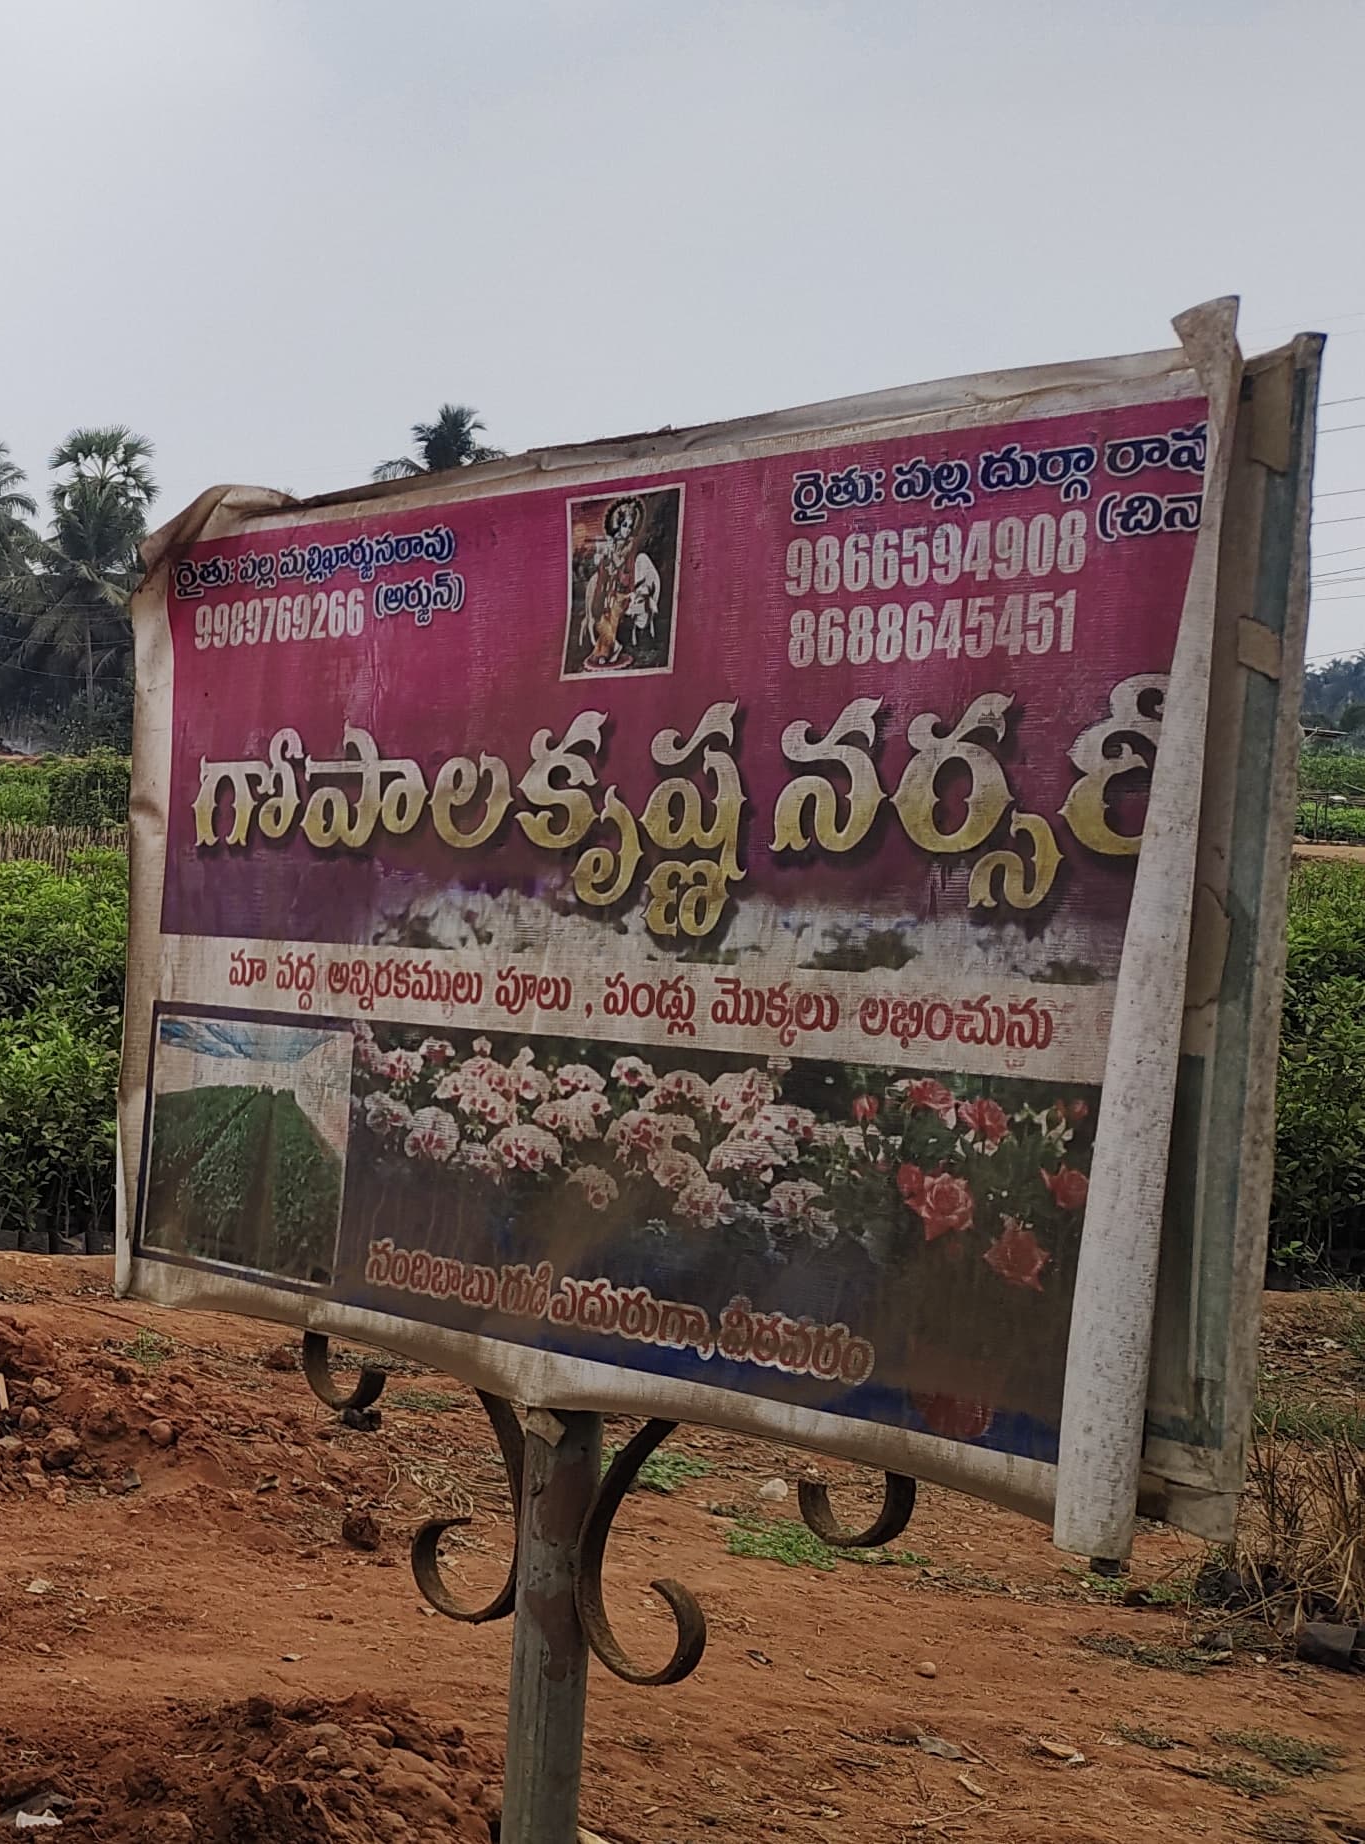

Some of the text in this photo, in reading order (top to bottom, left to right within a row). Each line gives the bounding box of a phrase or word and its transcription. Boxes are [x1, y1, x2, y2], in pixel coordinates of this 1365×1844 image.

[893, 457, 975, 509] పల్ల
[979, 444, 1096, 502] దుర్గా
[784, 510, 1088, 597] 9866594908
[195, 588, 365, 650] 9989769266
[789, 589, 1077, 668] 8688645451
[191, 697, 748, 936] గోపాలకృష్ణ
[228, 948, 267, 987] మా
[275, 952, 317, 1011] వద్ద
[496, 965, 572, 1015] పూలు
[603, 972, 697, 1035] పండ్లు
[711, 976, 839, 1047] మొక్కలు
[859, 993, 1054, 1050] లభించును
